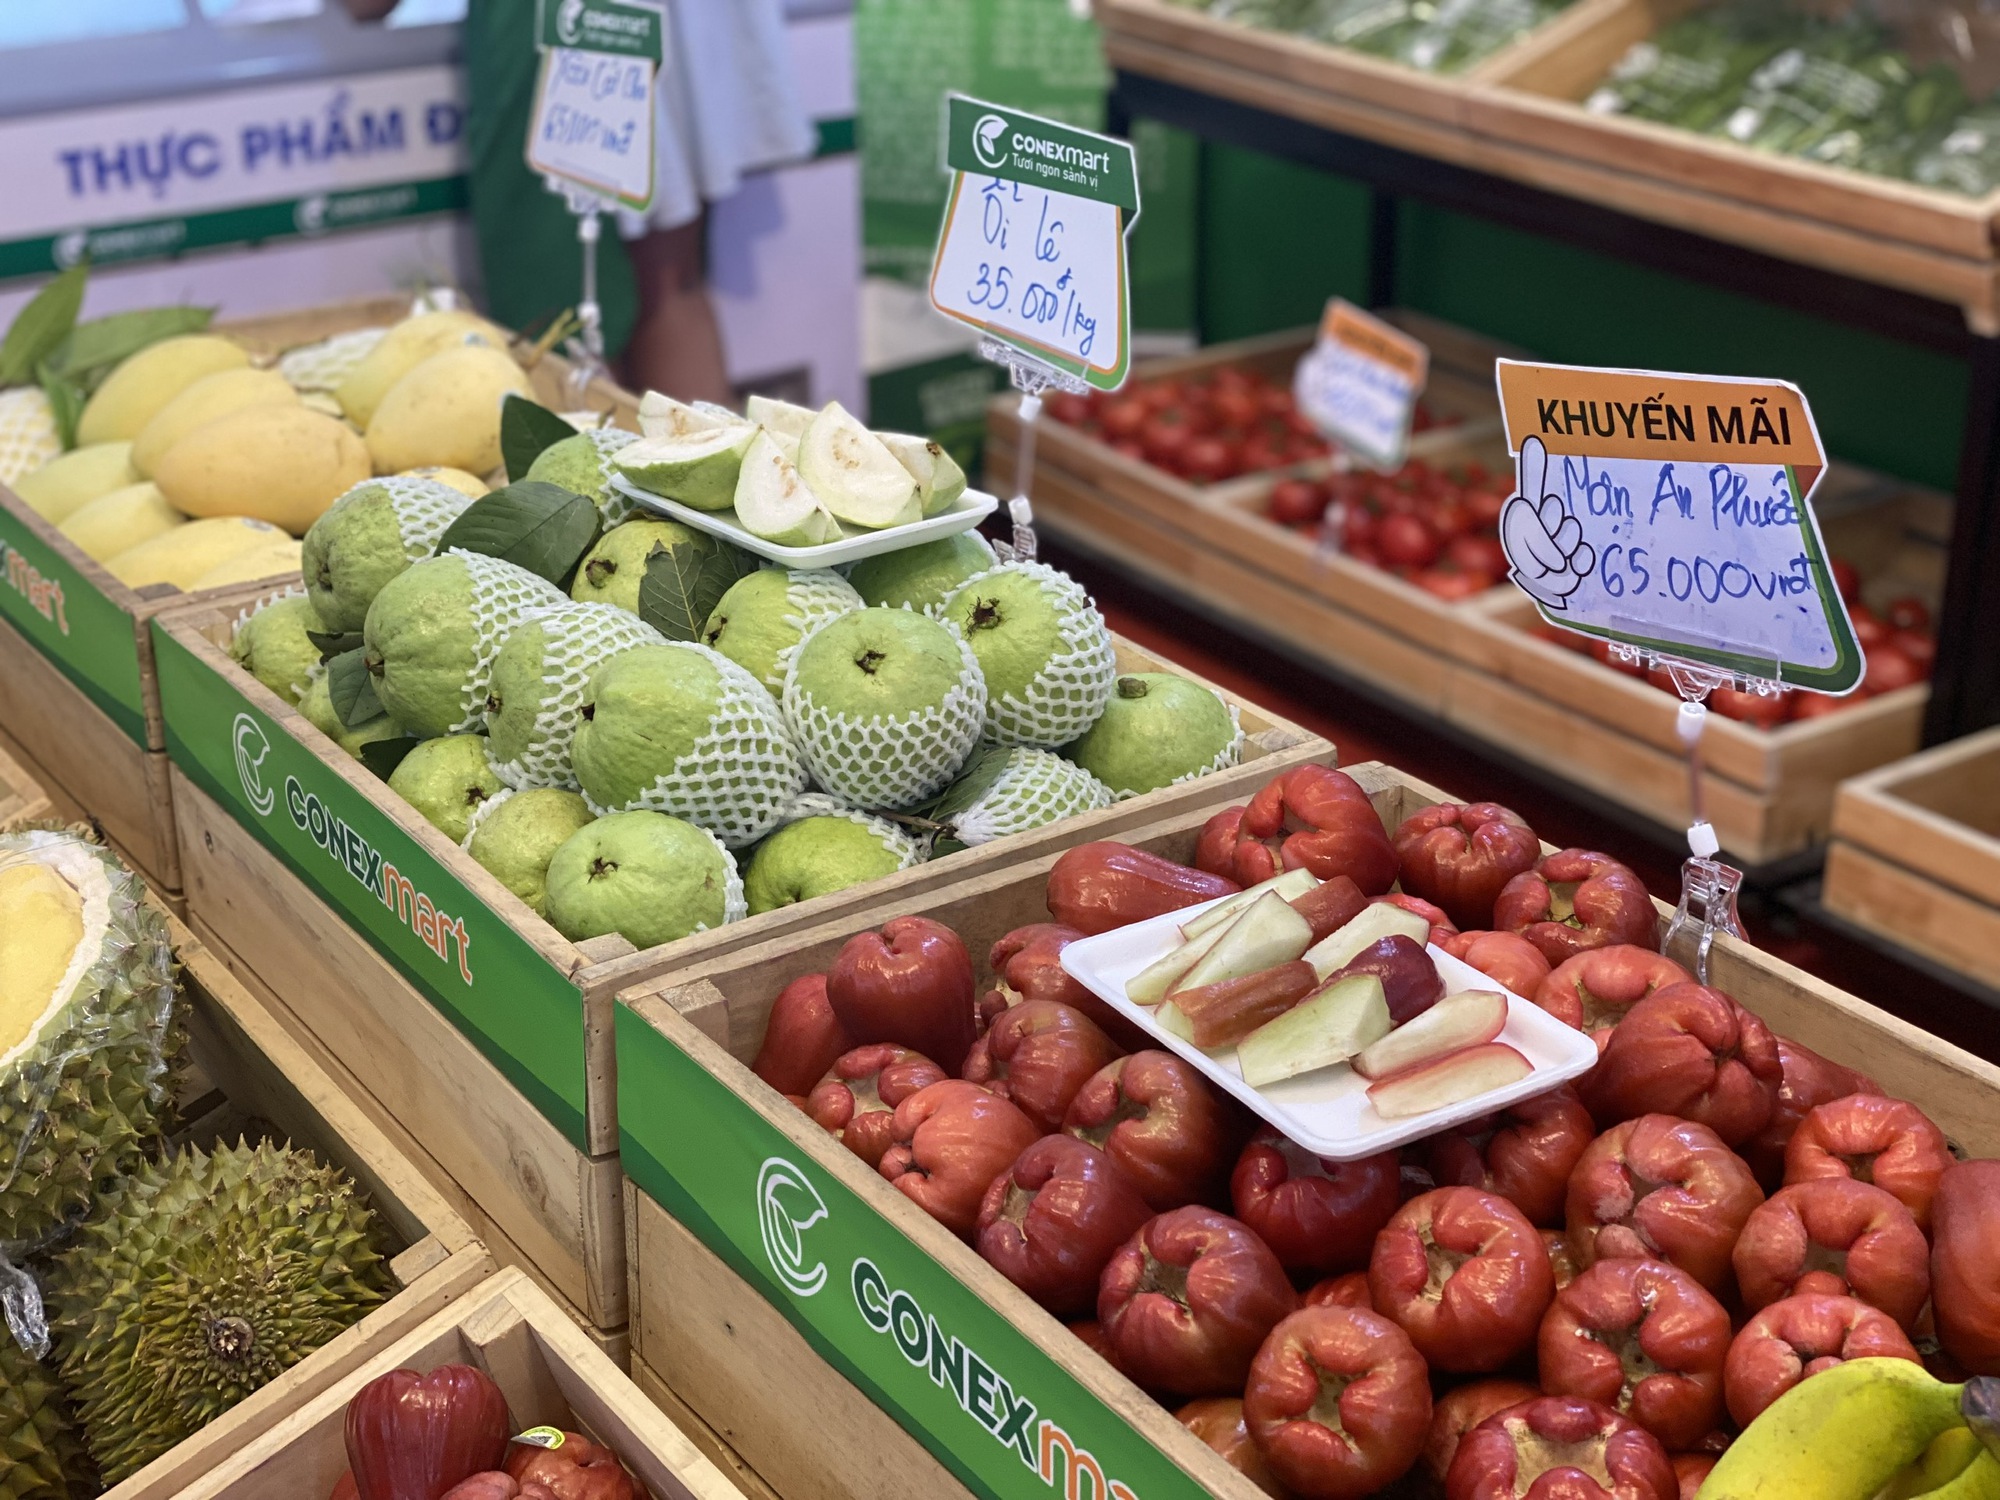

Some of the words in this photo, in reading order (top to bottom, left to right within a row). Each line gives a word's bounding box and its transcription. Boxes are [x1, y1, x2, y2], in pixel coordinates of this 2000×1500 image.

[57, 128, 222, 200] THỰC
[1012, 132, 1110, 174] CONEXmart
[1012, 152, 1034, 170] Tươi
[1036, 161, 1060, 178] ngon
[1063, 165, 1087, 185] sành
[1089, 174, 1099, 192] vị
[1537, 392, 1696, 442] KHUYẾN
[1707, 397, 1792, 446] MÃI
[1649, 462, 1695, 526] An
[285, 775, 473, 987] CONEXmart
